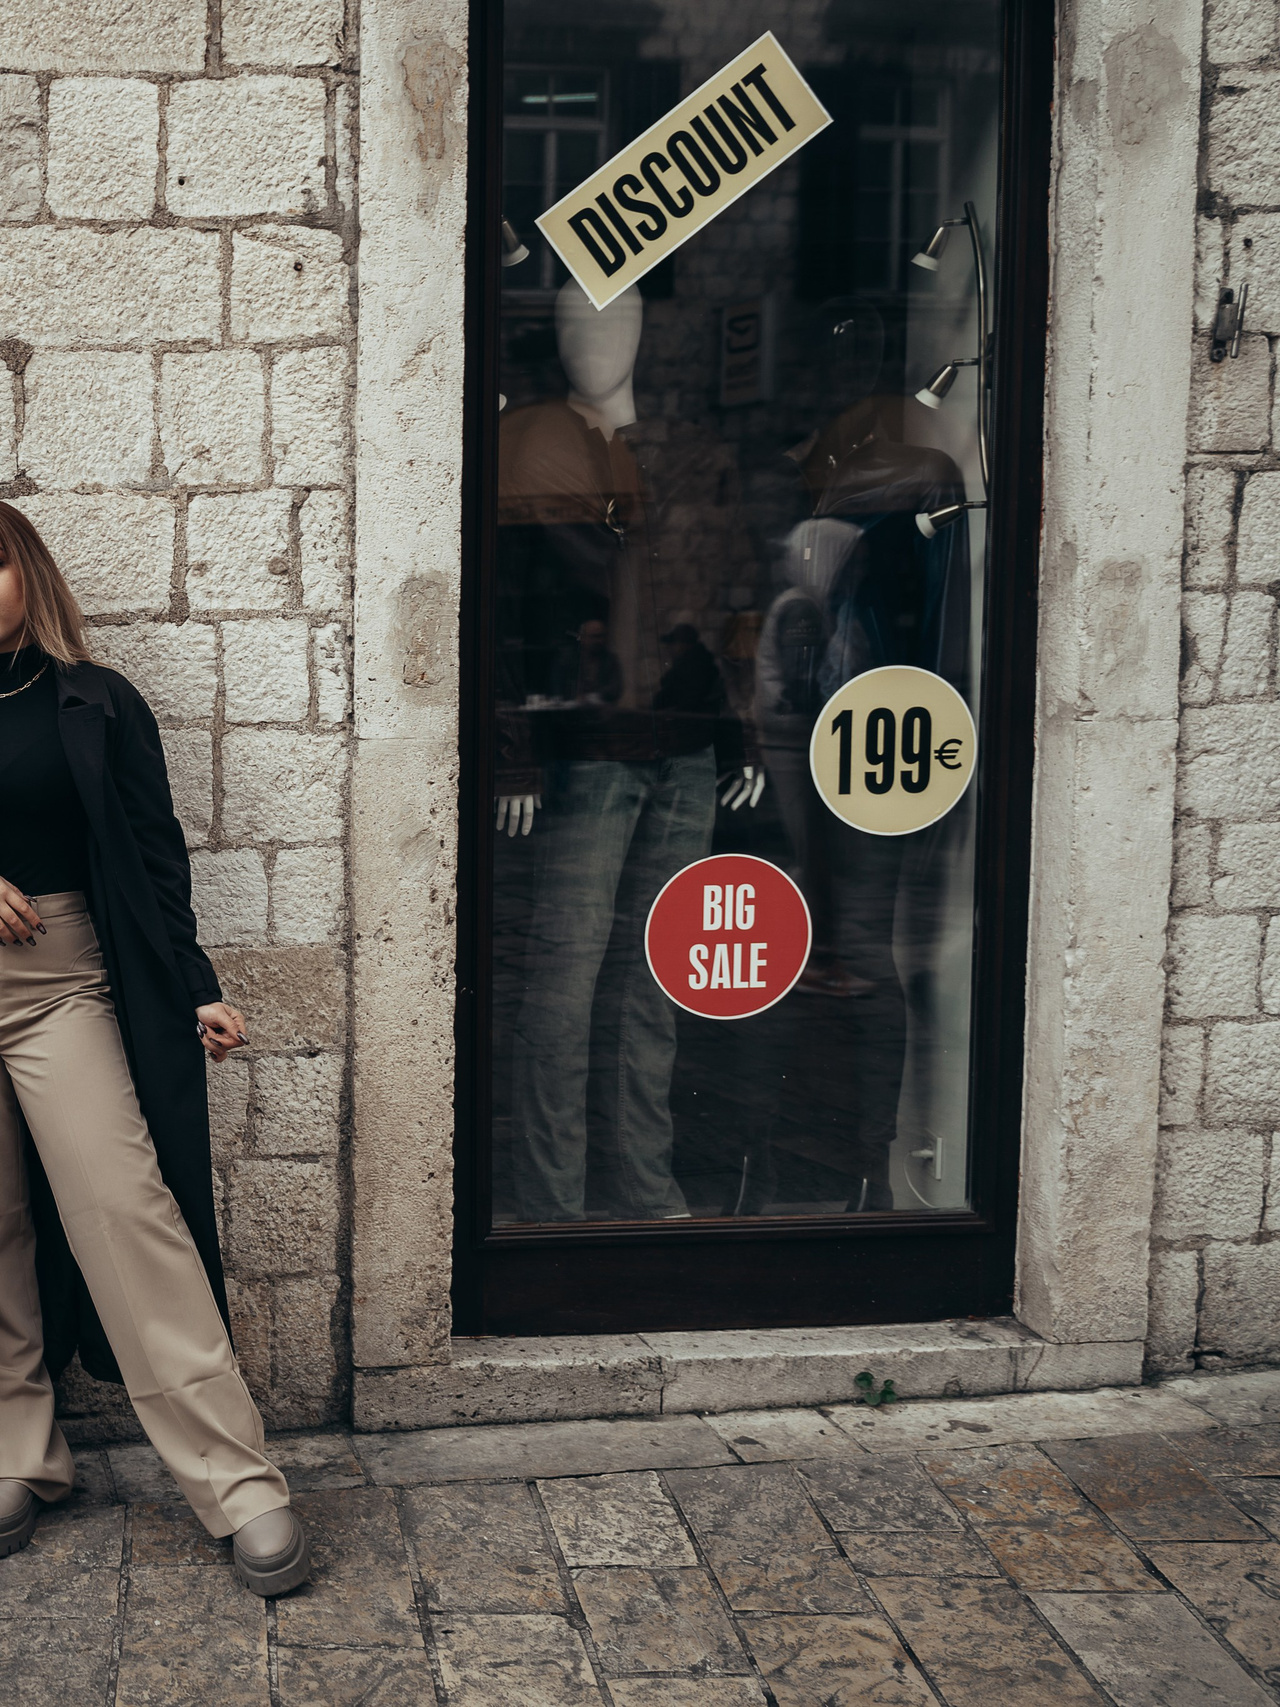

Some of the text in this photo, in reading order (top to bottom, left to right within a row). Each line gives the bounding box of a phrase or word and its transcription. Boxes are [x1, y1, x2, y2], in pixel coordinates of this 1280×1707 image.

[566, 62, 797, 278] DISCOUNT
[831, 706, 963, 795] 199€
[702, 883, 756, 931] BIG
[688, 942, 768, 990] SALE
